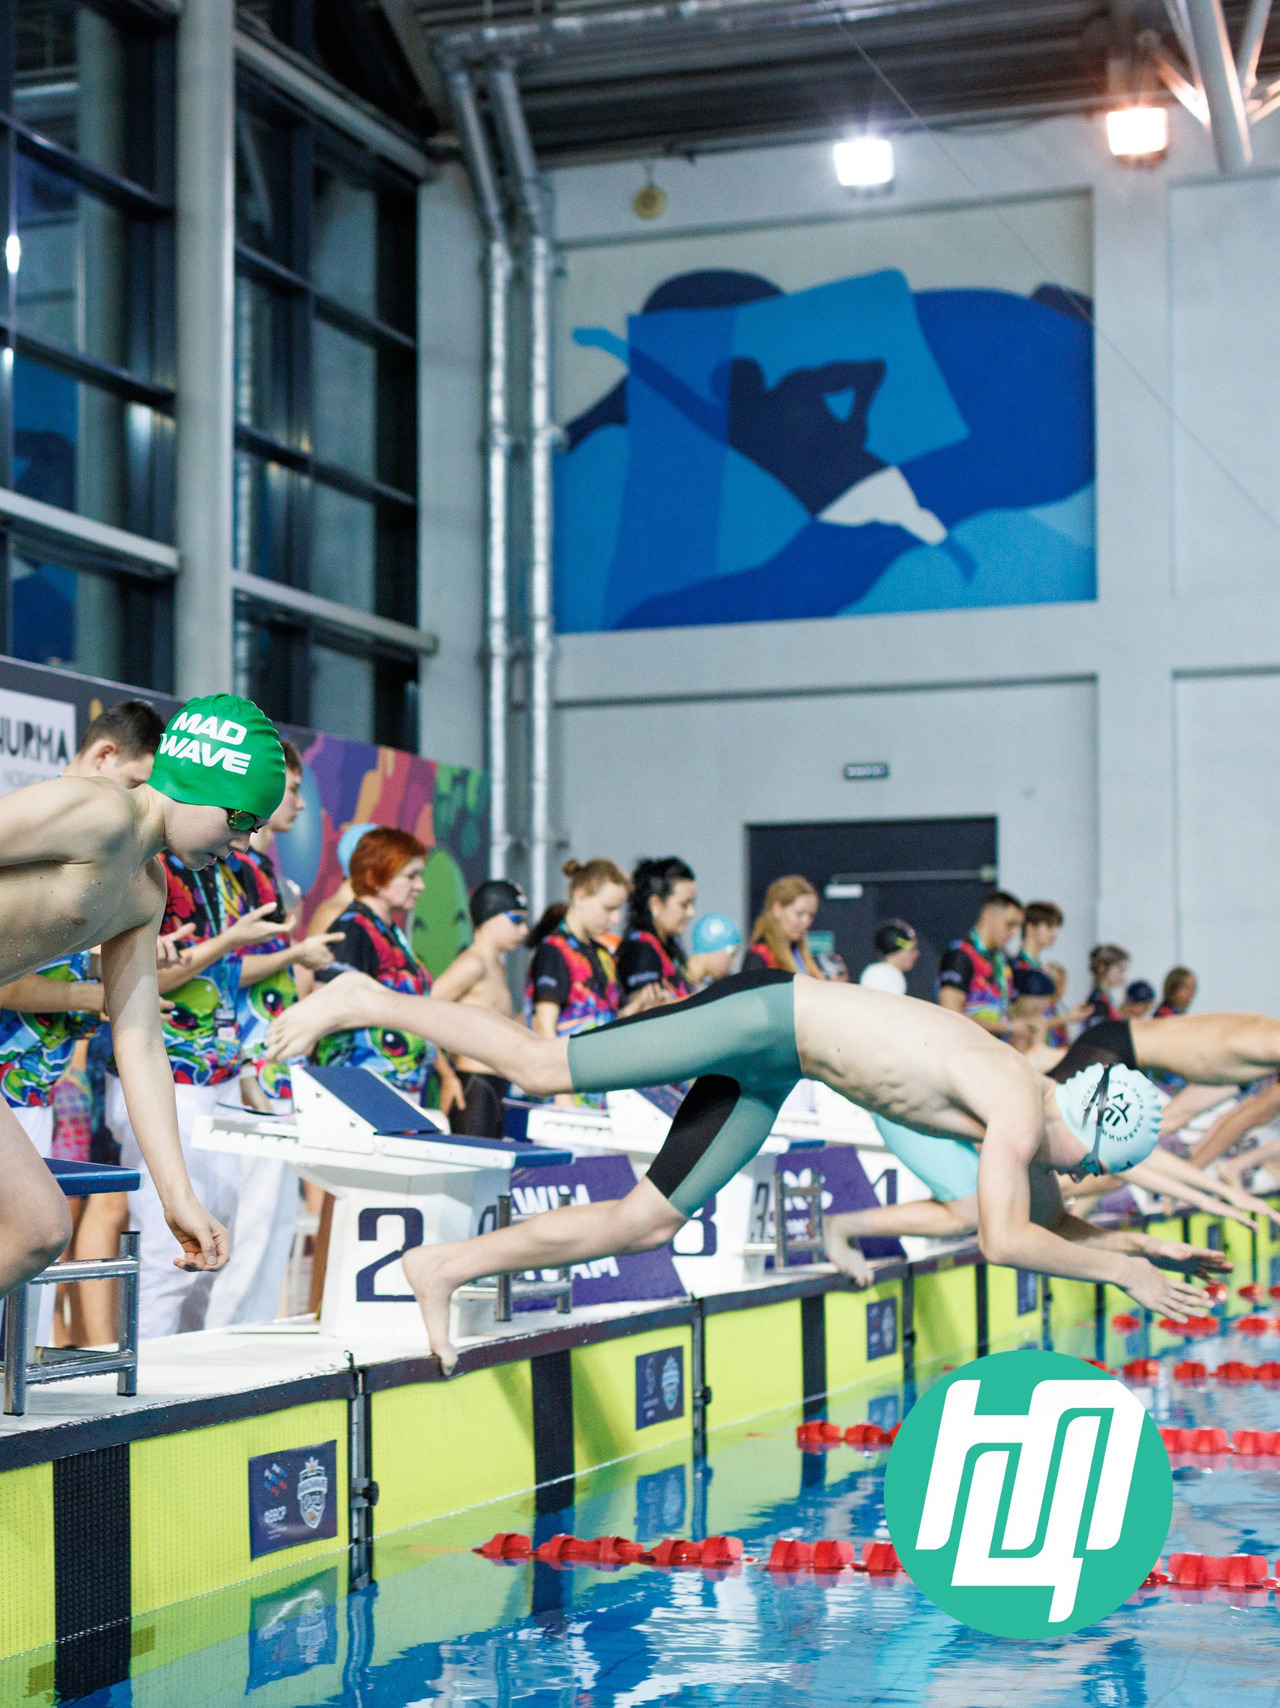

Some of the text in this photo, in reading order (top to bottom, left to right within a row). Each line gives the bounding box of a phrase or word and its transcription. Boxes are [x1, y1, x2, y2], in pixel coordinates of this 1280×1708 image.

[171, 711, 247, 746] MAD
[159, 733, 252, 776] WAVE
[356, 1207, 424, 1302] 2
